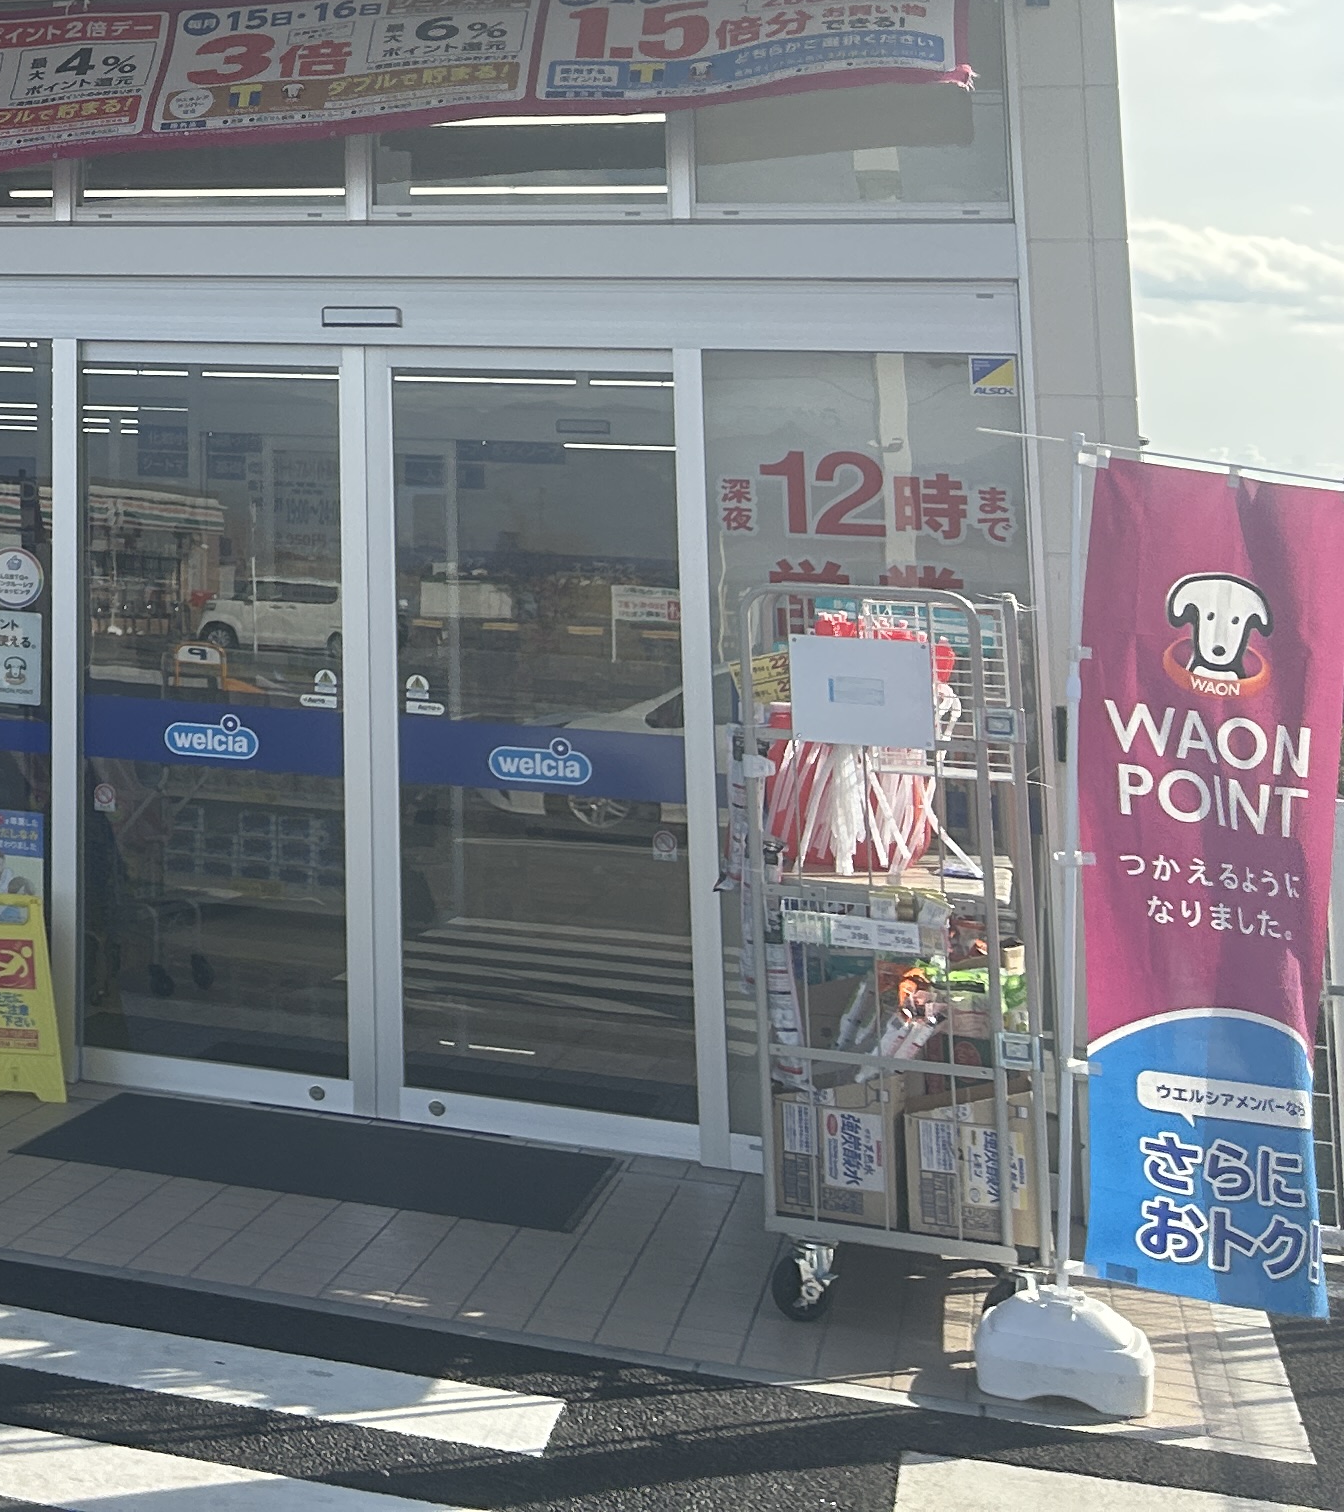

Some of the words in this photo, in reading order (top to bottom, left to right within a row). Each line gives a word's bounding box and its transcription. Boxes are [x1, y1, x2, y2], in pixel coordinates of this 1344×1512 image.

[822, 3, 926, 19] お買い物
[415, 16, 508, 41] 6%
[55, 47, 137, 76] 4%
[187, 33, 352, 85] 3倍
[382, 41, 507, 57] ポイント還元
[735, 33, 934, 65] どちらかご選択ください
[25, 75, 135, 96] ポイント還元
[327, 63, 509, 95] ダブルで貯まる!
[720, 476, 754, 533] 深夜
[759, 449, 969, 541] 12時
[977, 487, 1014, 543] まで
[1190, 675, 1241, 697] WAON
[173, 728, 249, 755] welcia
[1104, 699, 1312, 779] WAON
[498, 752, 582, 780] welcia
[1117, 763, 1309, 838] POINT
[1119, 853, 1301, 900] つかえるように
[1147, 896, 1294, 942] なりました。
[1156, 1083, 1306, 1117] ウエルシアメンバーなら
[1139, 1131, 1305, 1209] さらに
